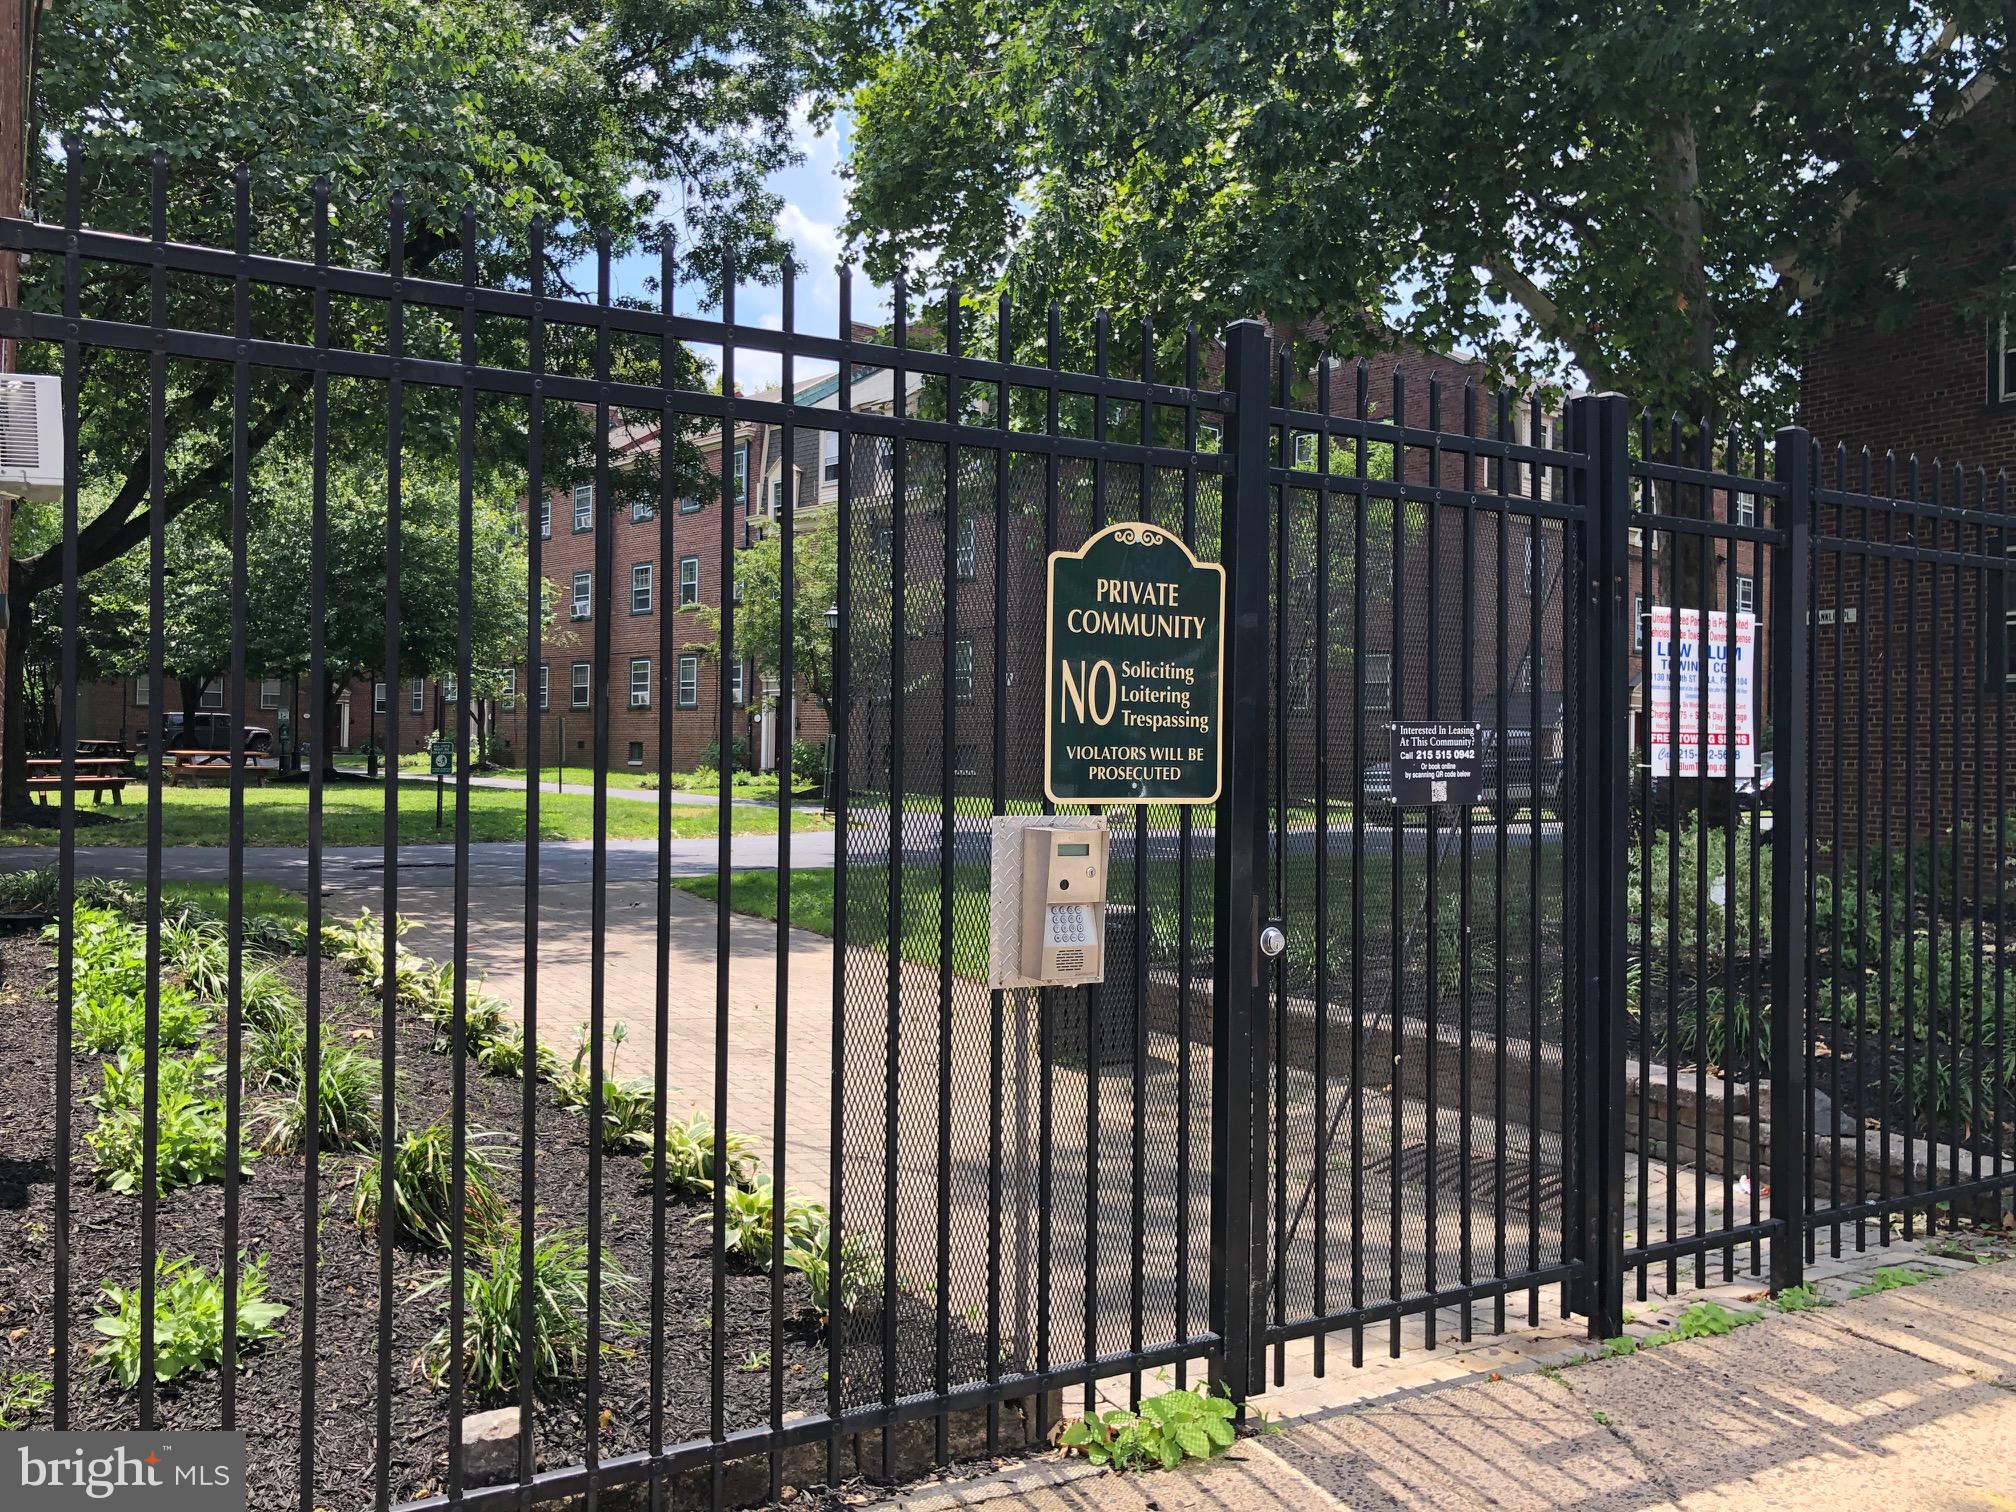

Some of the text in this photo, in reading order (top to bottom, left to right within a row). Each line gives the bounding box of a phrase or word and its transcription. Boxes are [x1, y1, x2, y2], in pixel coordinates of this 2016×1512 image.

[1096, 578, 1179, 607] PRIVATE
[1067, 609, 1206, 640] COMMUNITY
[1121, 660, 1195, 686] Soliciting
[1661, 658, 1702, 672] TWIN
[1060, 658, 1117, 726] NO
[1121, 685, 1191, 710] Loitering
[1121, 709, 1209, 734] Trespassing
[1400, 725, 1474, 737] Interested In Leasing
[1651, 733, 1674, 743] FRE
[1400, 737, 1475, 748] At This Community?
[1066, 745, 1204, 762] VIOLATORS WILL BE
[1400, 749, 1475, 760] Call 215 515 0942
[1088, 765, 1181, 782] PROSECUTED
[1404, 770, 1471, 780] by scanning QR code below
